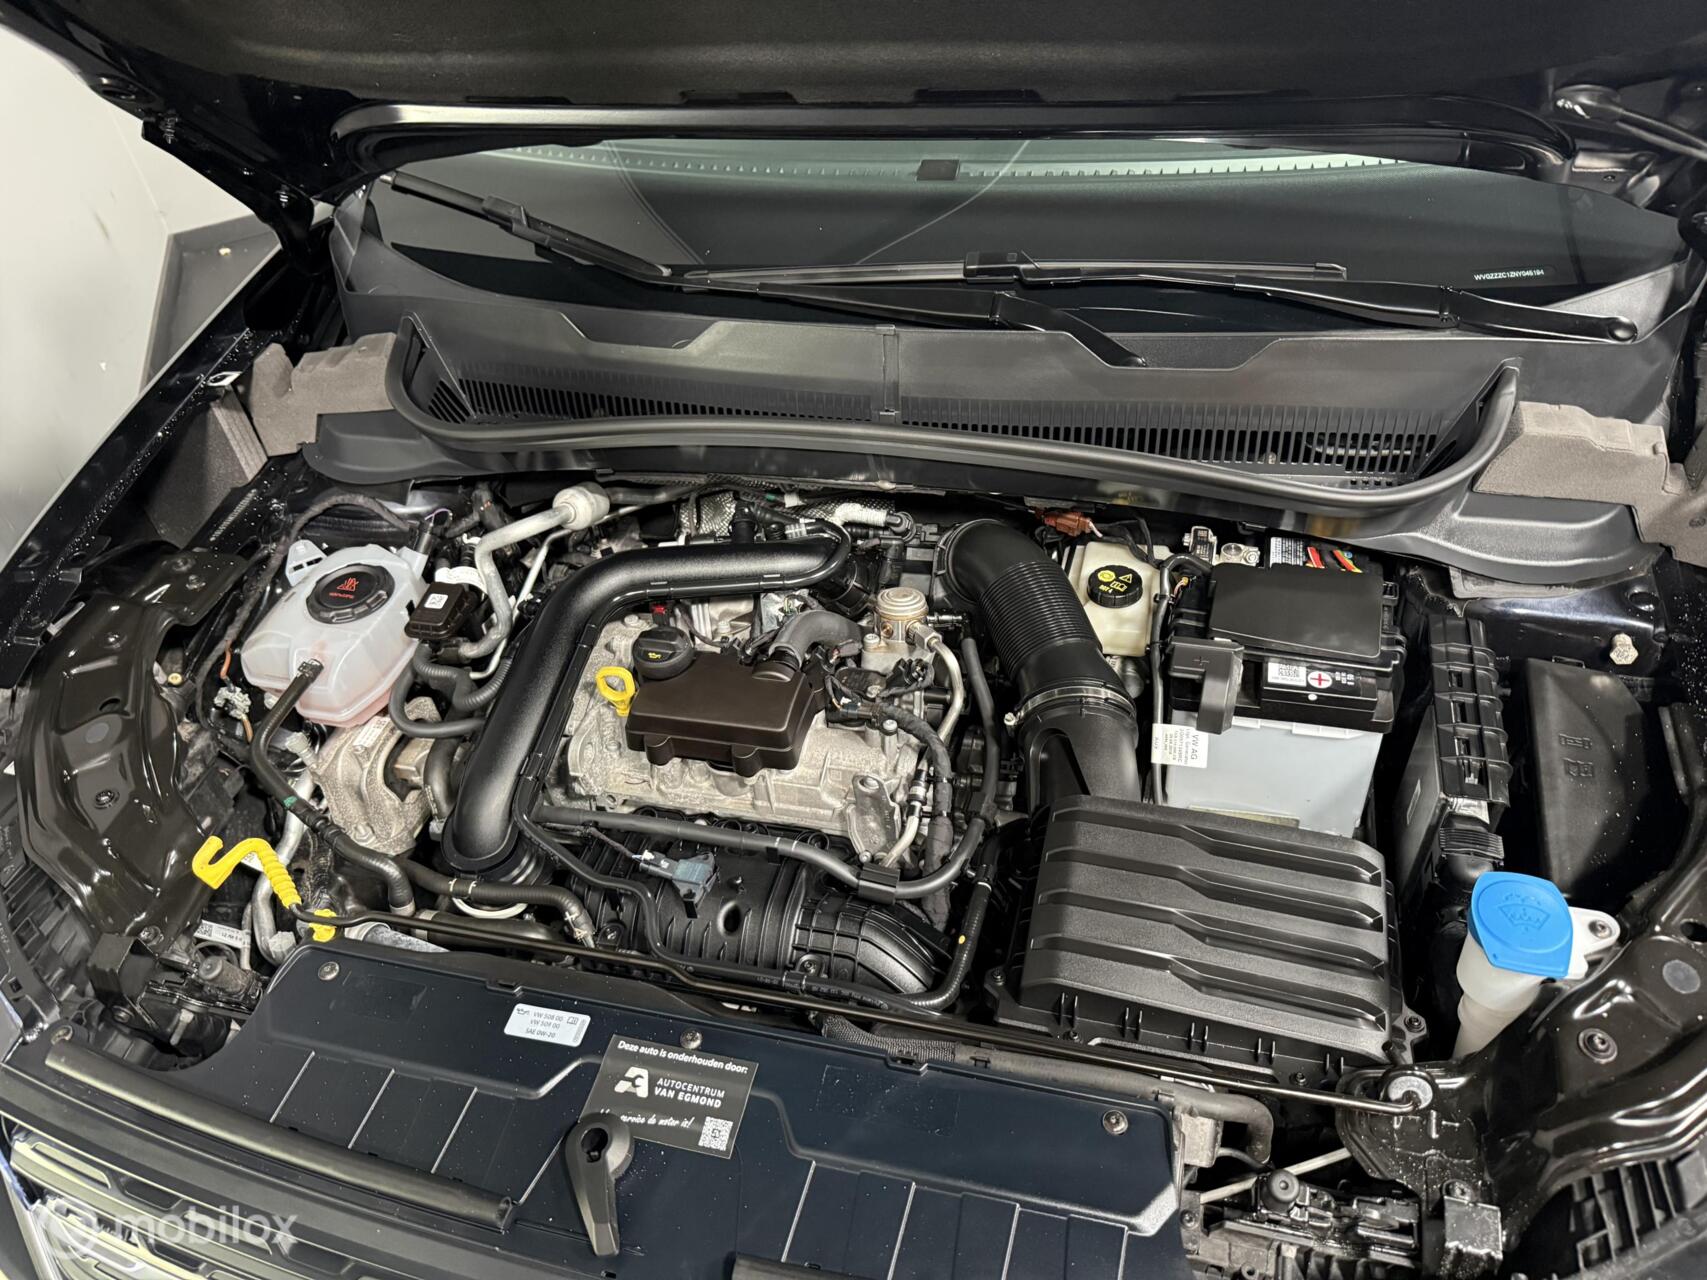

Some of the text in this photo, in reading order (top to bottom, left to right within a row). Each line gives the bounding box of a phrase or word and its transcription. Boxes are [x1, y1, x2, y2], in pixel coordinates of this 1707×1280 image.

[617, 1040, 749, 1074] Deze auto is onderhouden door:
[654, 1086, 722, 1108] VAN EGMOND
[657, 1077, 726, 1098] AUTOCENTRUM
